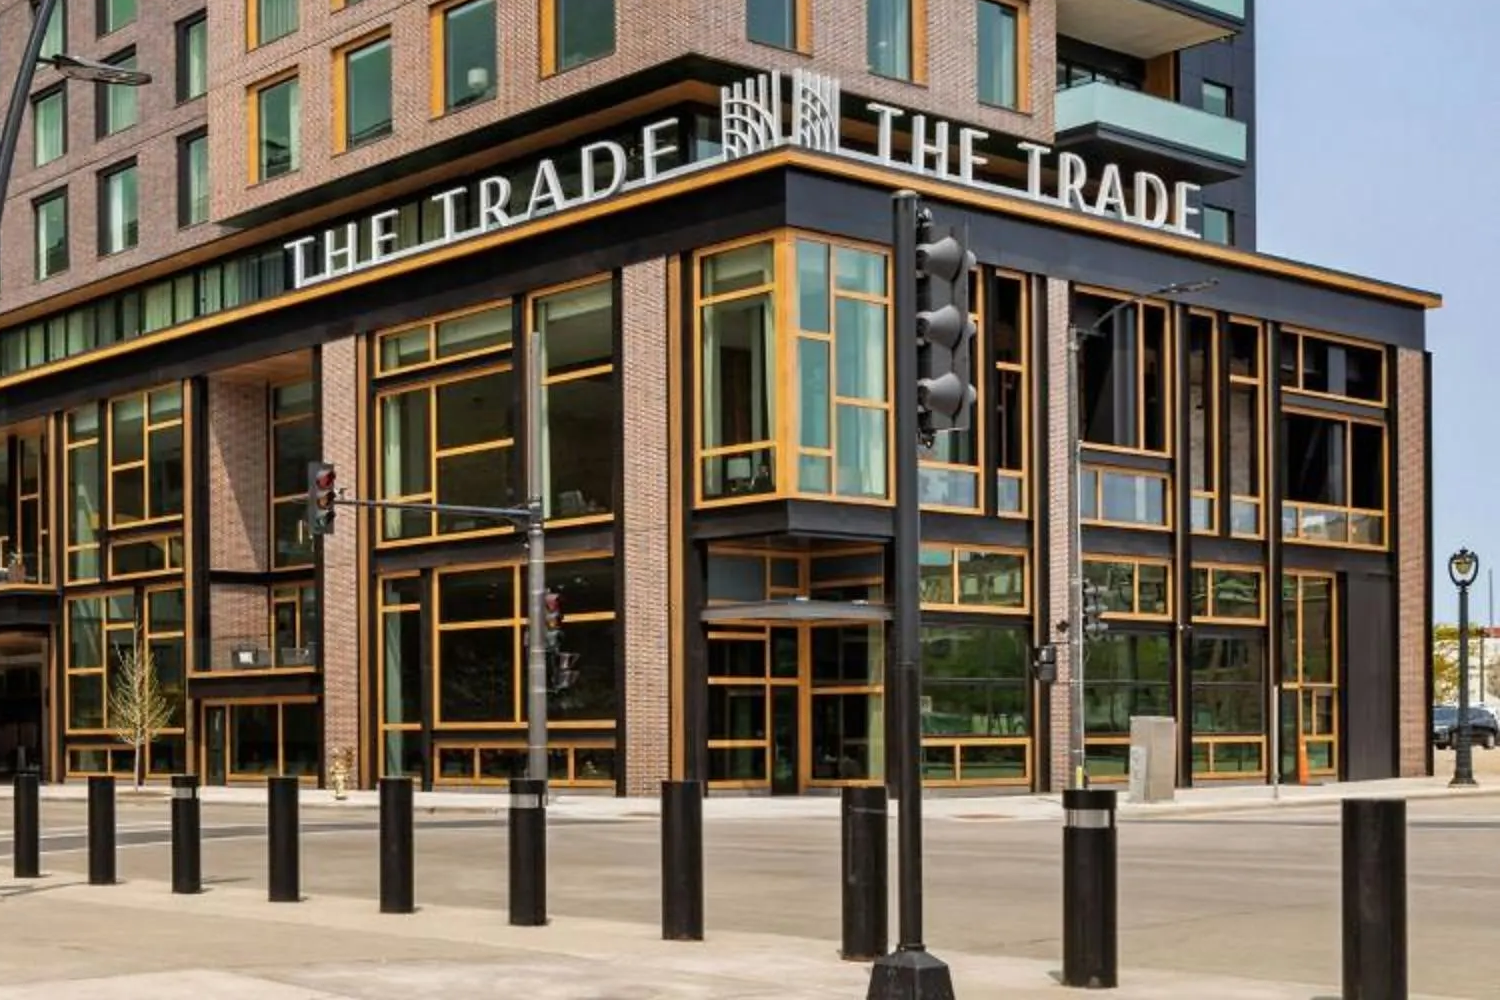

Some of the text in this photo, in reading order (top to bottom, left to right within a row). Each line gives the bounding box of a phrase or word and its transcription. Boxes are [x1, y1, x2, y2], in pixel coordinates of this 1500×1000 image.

[284, 117, 680, 288] THE TRADE
[866, 103, 1202, 239] THE TRADE
